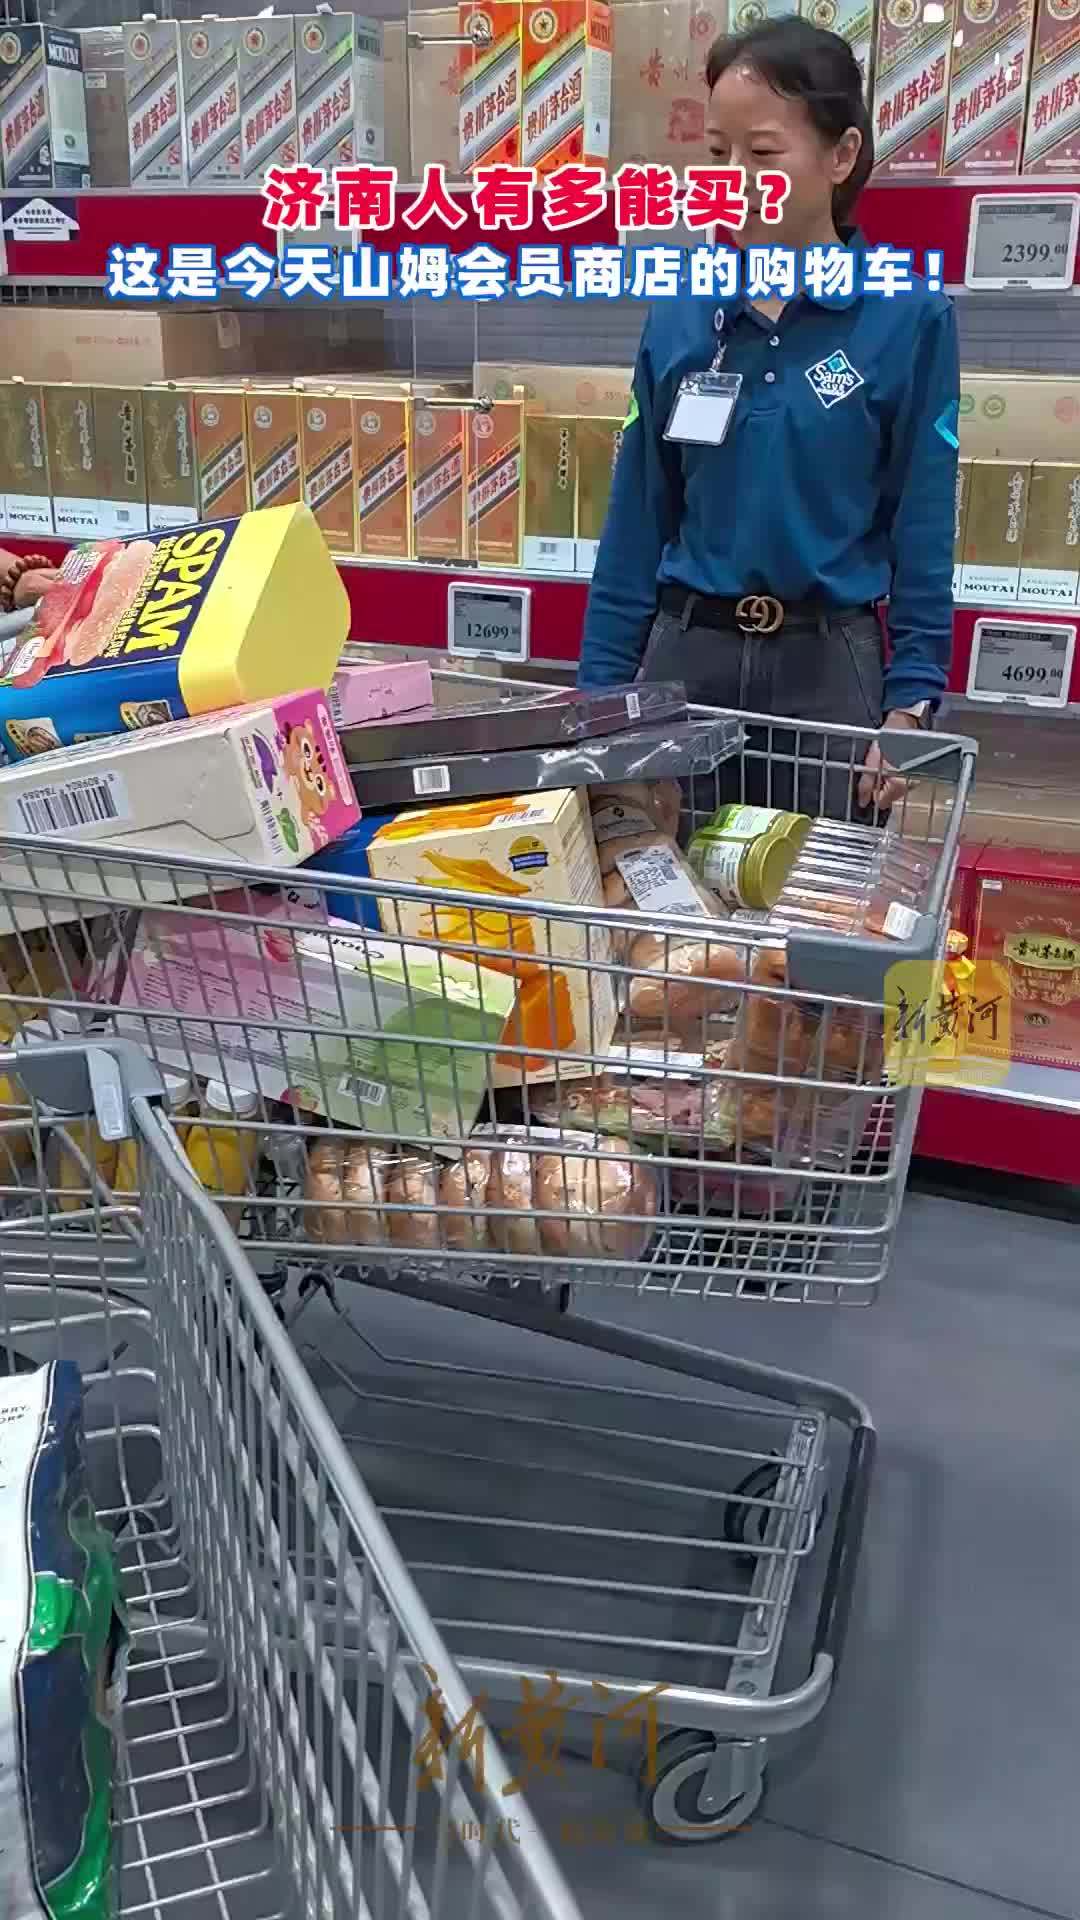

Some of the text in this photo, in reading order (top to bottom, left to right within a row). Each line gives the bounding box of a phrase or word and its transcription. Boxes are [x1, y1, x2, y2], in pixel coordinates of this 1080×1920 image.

[876, 53, 947, 137] 贵州茅台酒
[124, 528, 226, 654] SPAM
[964, 583, 1014, 593] MOUTAI
[1021, 587, 1073, 597] MOUTAI
